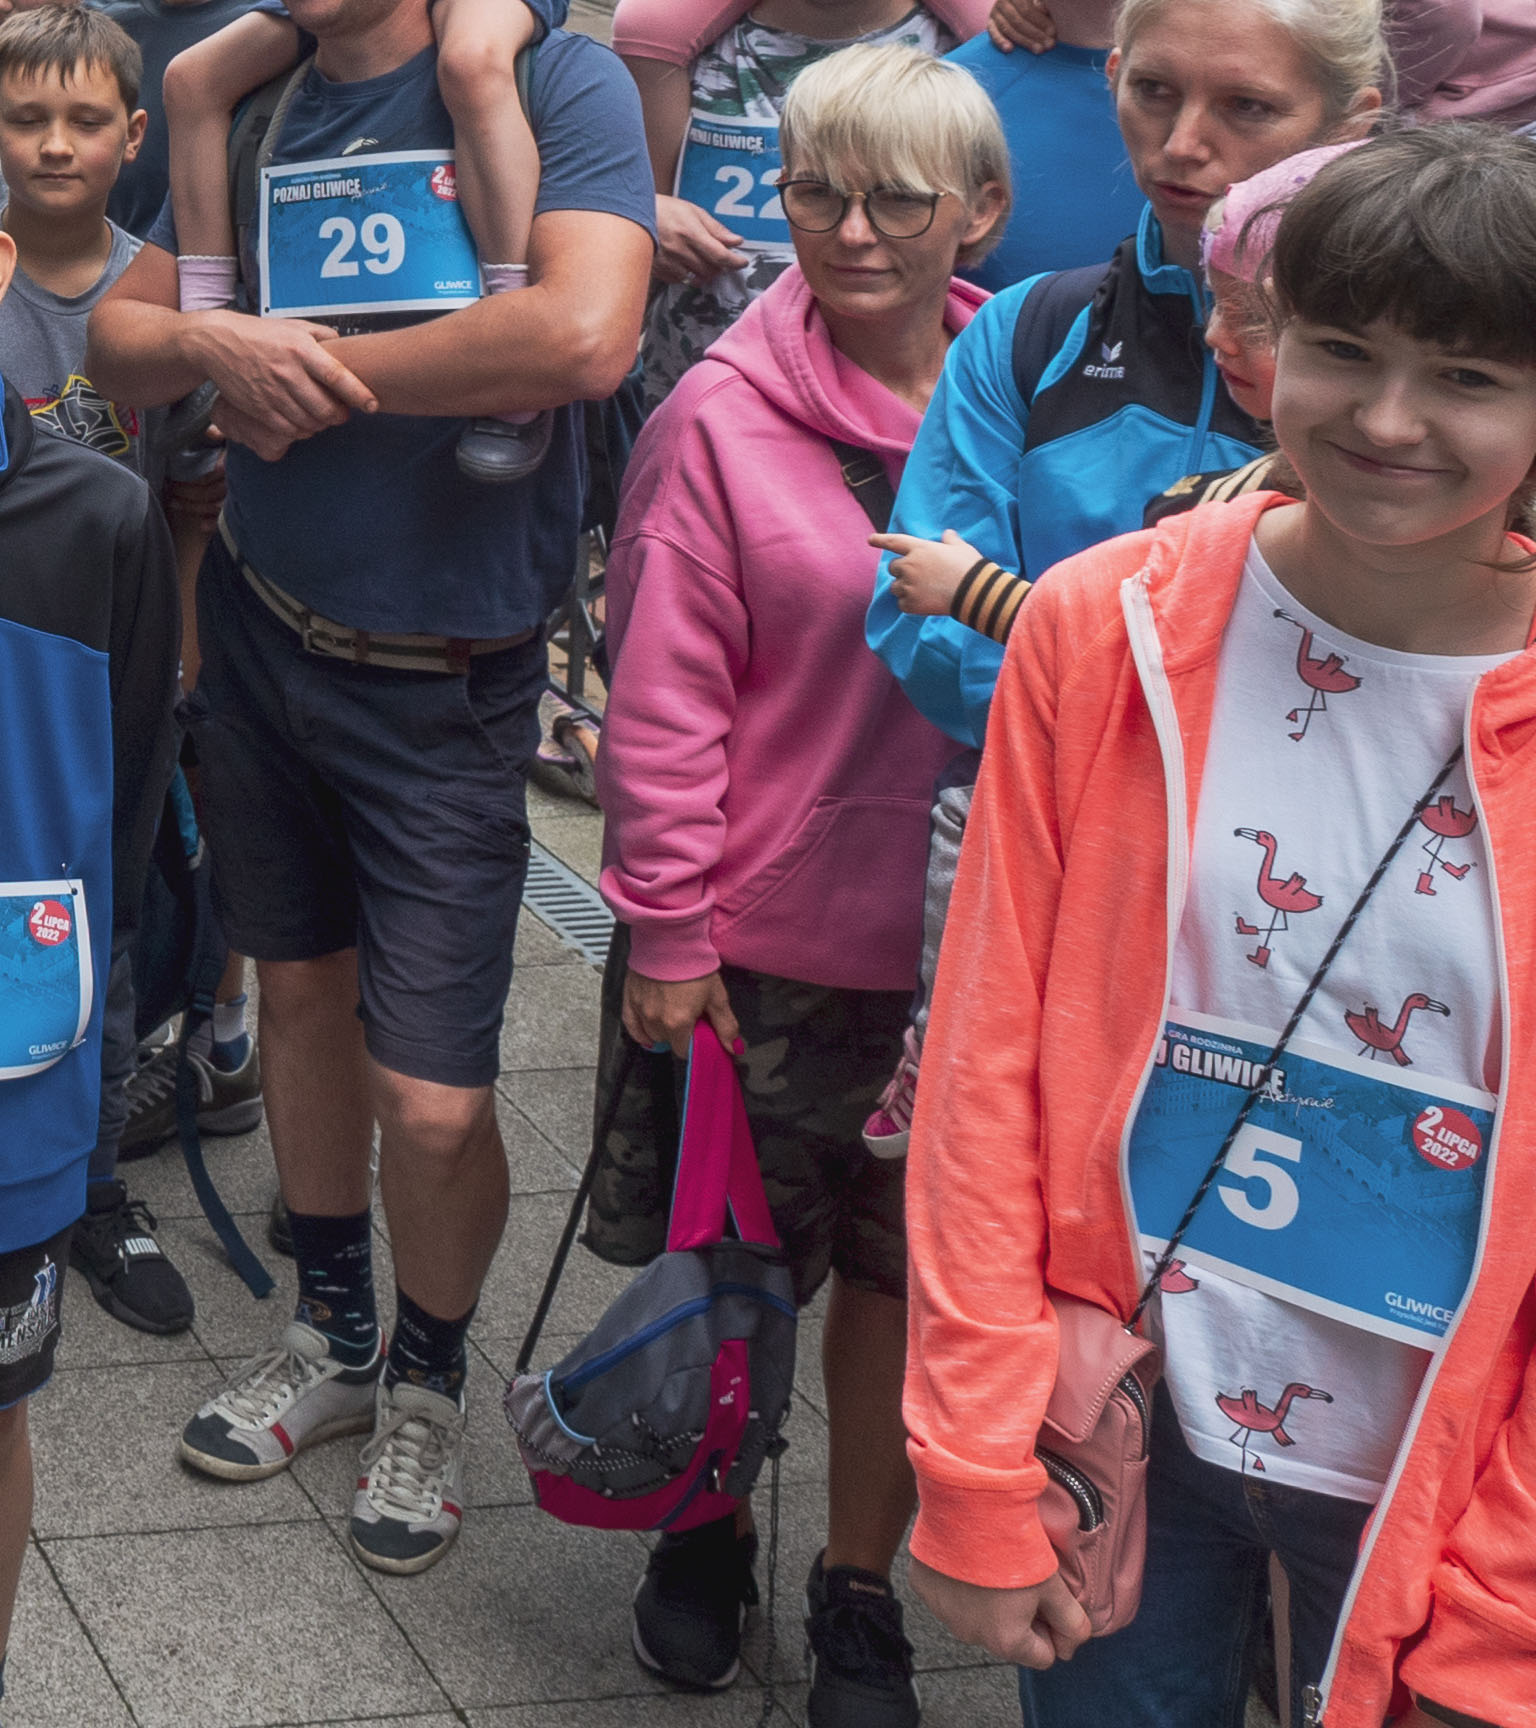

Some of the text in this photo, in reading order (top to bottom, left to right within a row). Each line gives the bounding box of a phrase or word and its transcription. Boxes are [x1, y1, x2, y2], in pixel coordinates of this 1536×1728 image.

[712, 133, 764, 150] GLIWICE
[432, 165, 446, 184] 2
[273, 182, 311, 204] POZNAJ
[313, 178, 361, 199] GLIWICE
[318, 213, 406, 279] 29
[434, 280, 473, 290] GLIWICE
[1083, 363, 1126, 379] erima
[32, 902, 70, 932] 2 LIPCA
[36, 925, 60, 942] 2022
[29, 1039, 67, 1055] GLIWICE
[1168, 1028, 1190, 1042] GRA
[1190, 1032, 1243, 1056] RODZINNA
[1173, 1048, 1286, 1094] GLIWICE
[1415, 1105, 1478, 1160] 2 LIPCA
[1420, 1137, 1460, 1167] 2022
[1217, 1122, 1303, 1231] 5
[1384, 1290, 1454, 1323] GLIWICE
